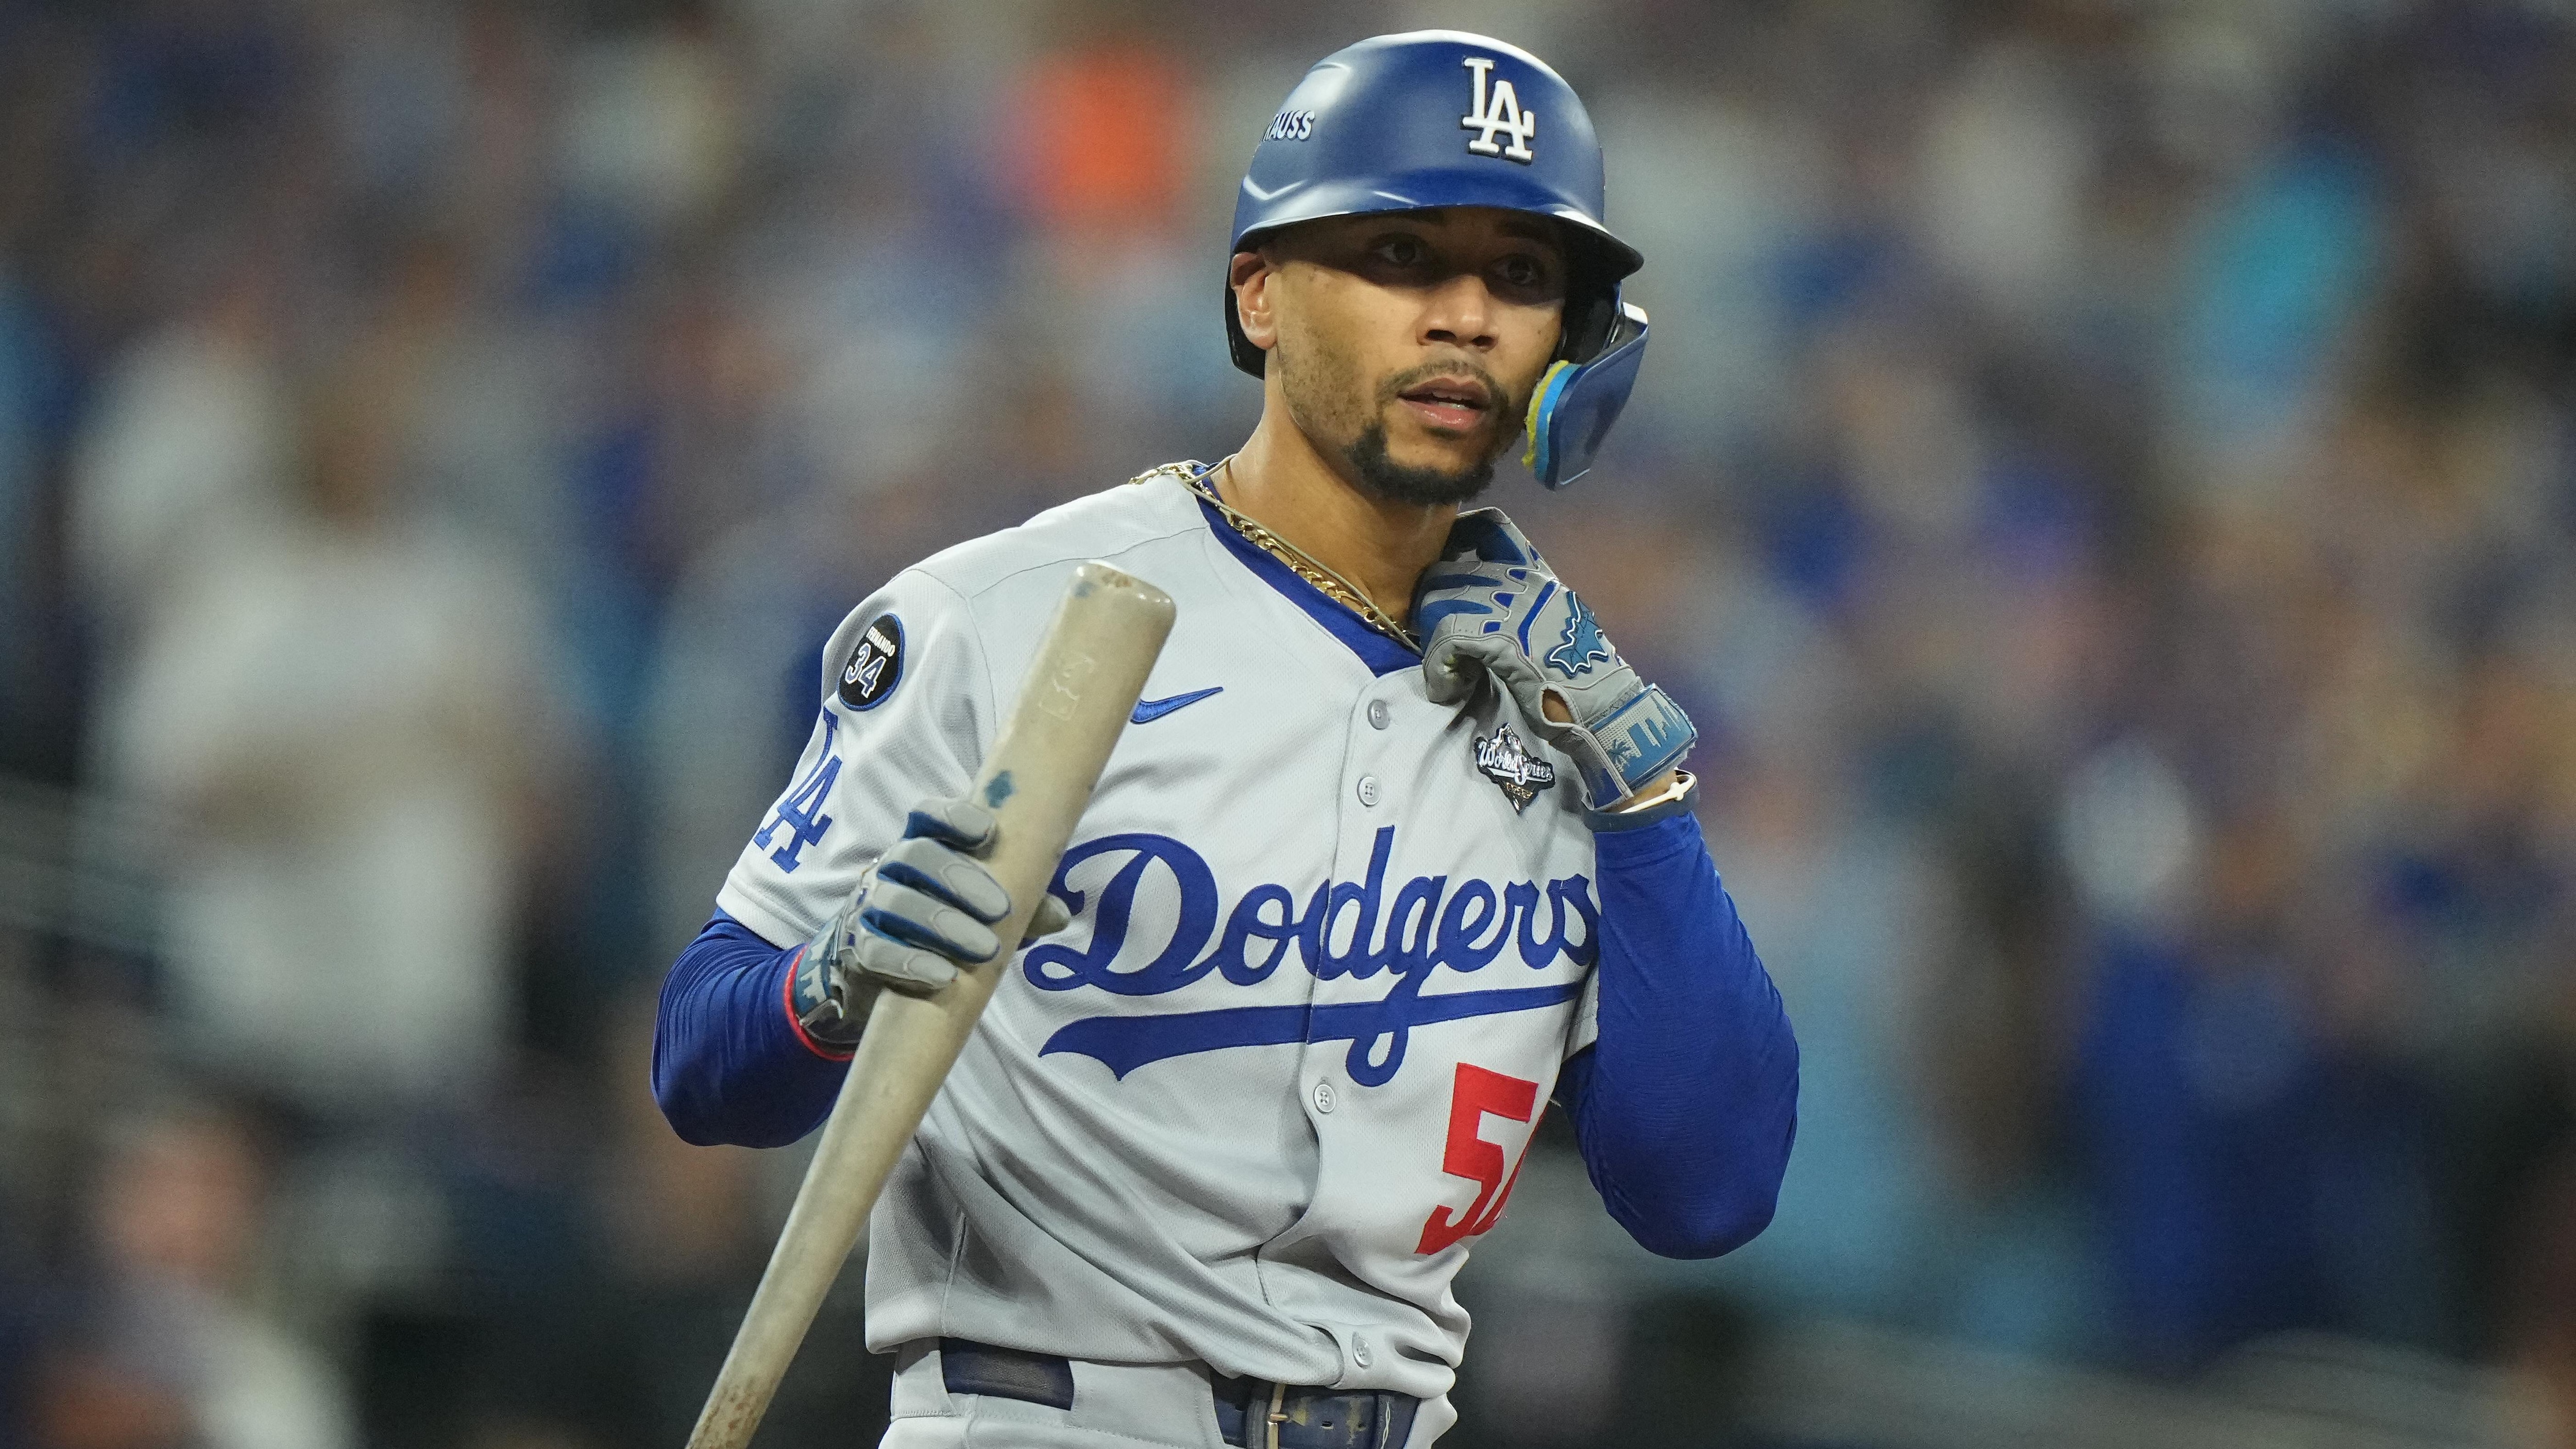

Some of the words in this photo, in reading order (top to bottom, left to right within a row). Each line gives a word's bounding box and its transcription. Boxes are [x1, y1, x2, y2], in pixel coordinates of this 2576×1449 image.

[1462, 57, 1534, 161] LA
[845, 643, 886, 698] 34
[753, 706, 842, 874] LA
[1478, 741, 1521, 772] World
[1514, 754, 1553, 785] Series
[1023, 825, 1599, 1087] Dodgers
[1414, 1062, 1548, 1255] 5
